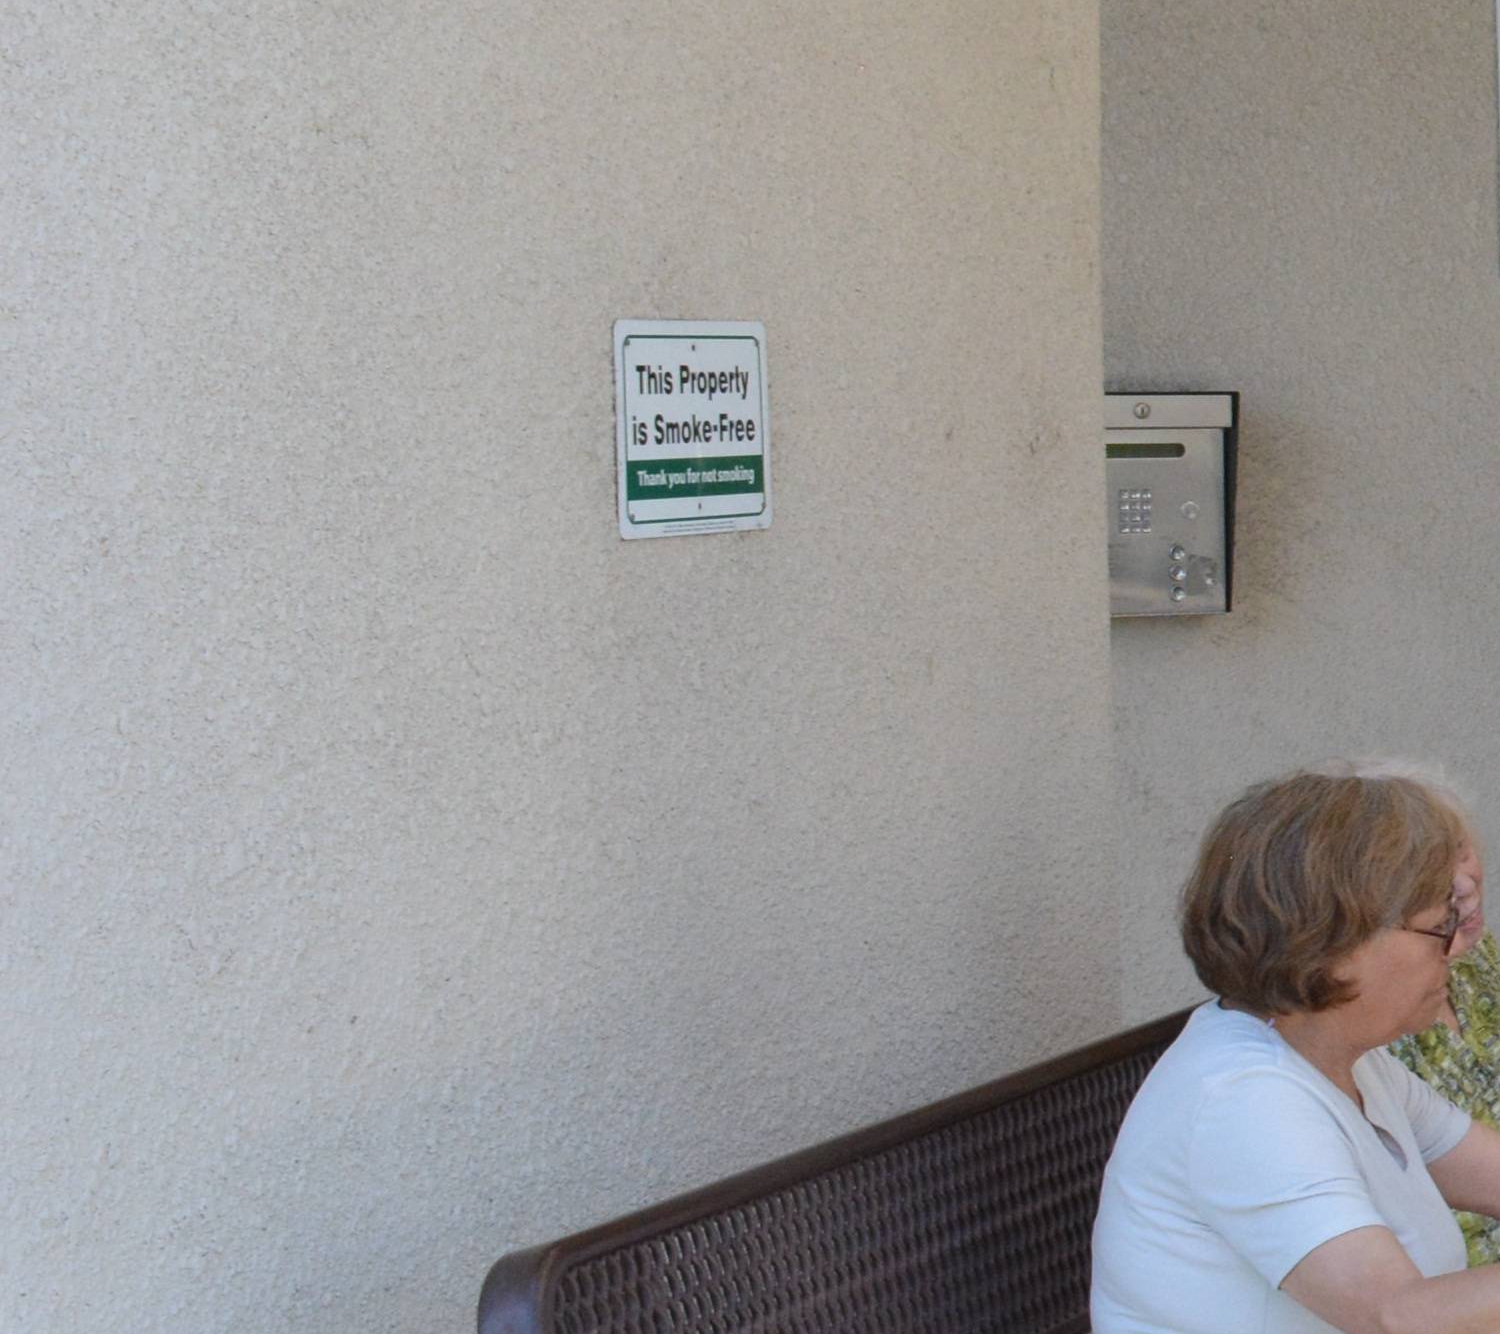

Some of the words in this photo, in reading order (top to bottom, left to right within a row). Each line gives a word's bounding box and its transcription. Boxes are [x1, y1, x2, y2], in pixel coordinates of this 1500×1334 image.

[635, 365, 673, 395] This
[679, 365, 749, 400] Property
[632, 416, 648, 445] is
[654, 414, 755, 445] Smoke-Free
[637, 470, 668, 487] Thank
[668, 471, 687, 489] you
[687, 467, 702, 484] for
[702, 468, 718, 483] not
[717, 465, 755, 485] smoking
